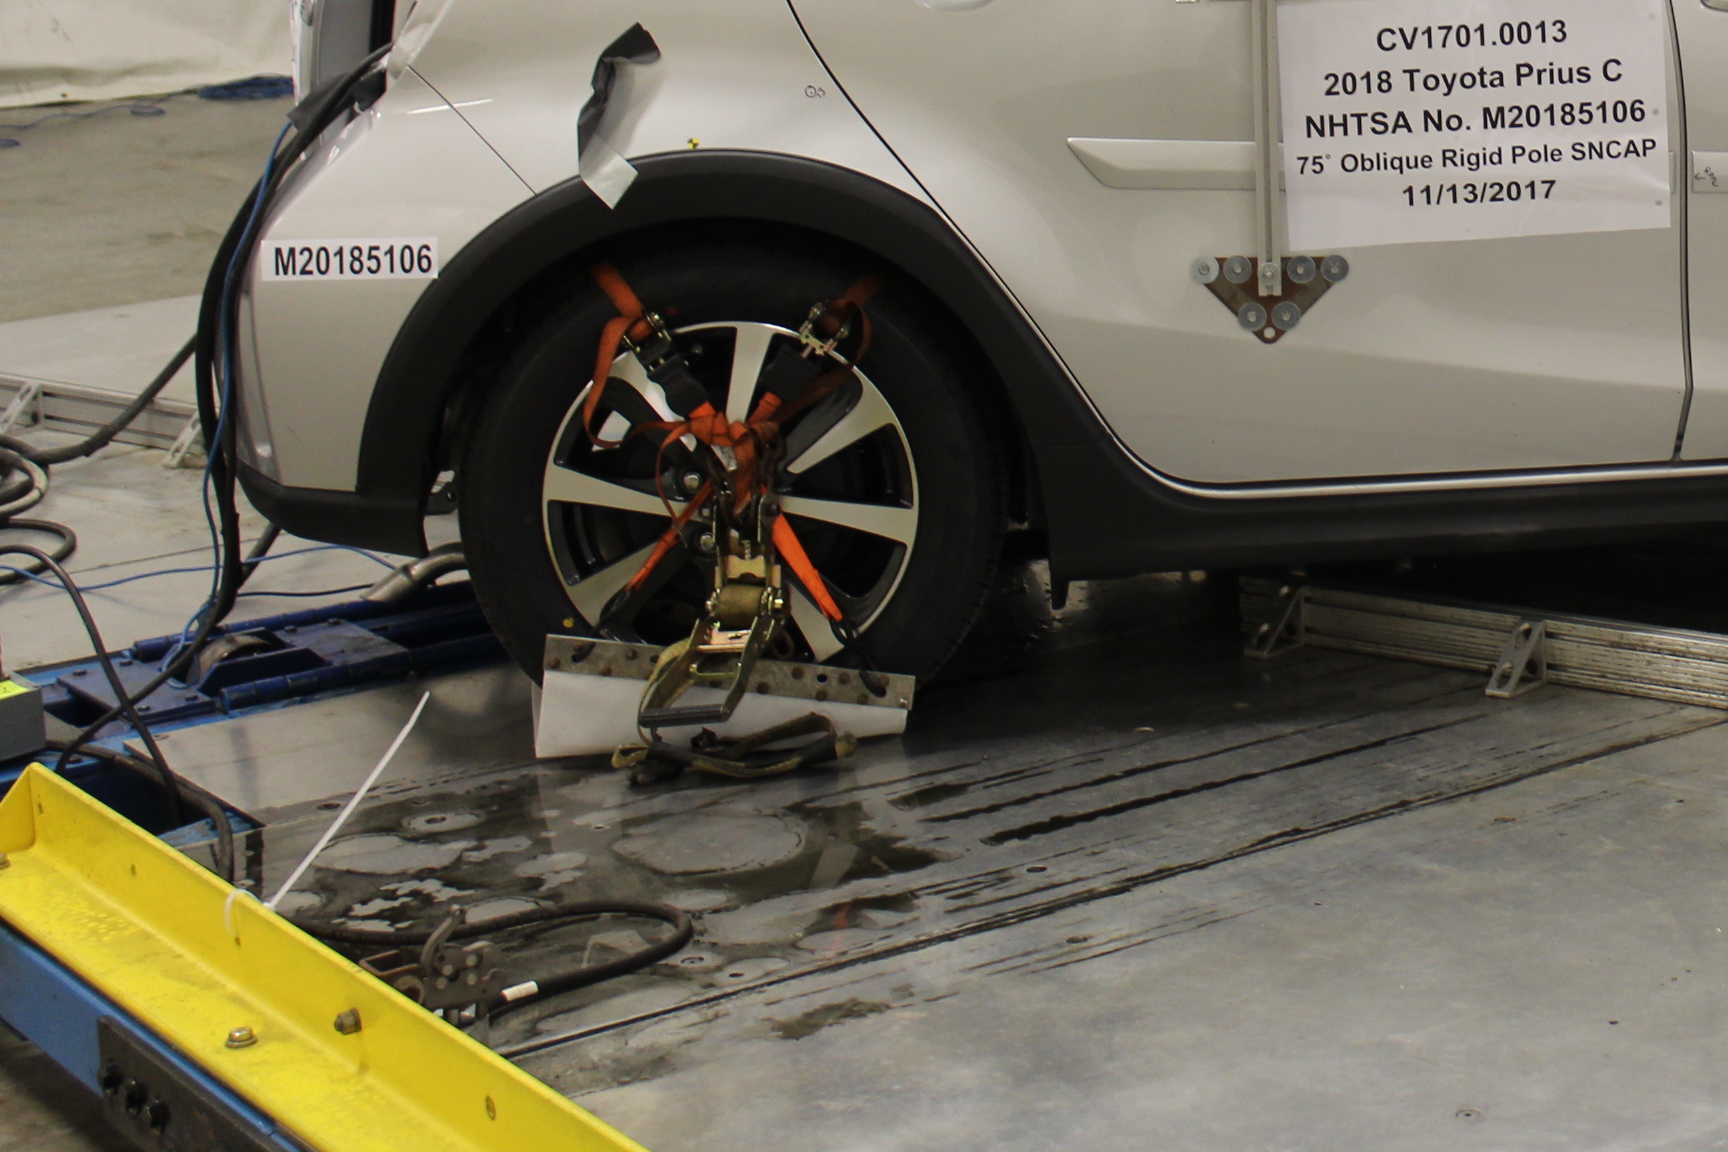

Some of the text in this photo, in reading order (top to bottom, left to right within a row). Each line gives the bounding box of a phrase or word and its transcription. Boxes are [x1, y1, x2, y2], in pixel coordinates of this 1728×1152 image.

[1376, 19, 1567, 52] CV1701.0013
[1324, 58, 1623, 96] 2018 Toyota Prius C
[1306, 99, 1645, 138] NHTSA No. M20185106
[1340, 149, 1433, 174] Oblique
[1442, 146, 1503, 171] Rigid
[1512, 143, 1563, 164] Pole
[1571, 138, 1657, 161] SNCAP
[1402, 179, 1556, 206] 11/13/2017
[274, 244, 432, 276] M20185106
